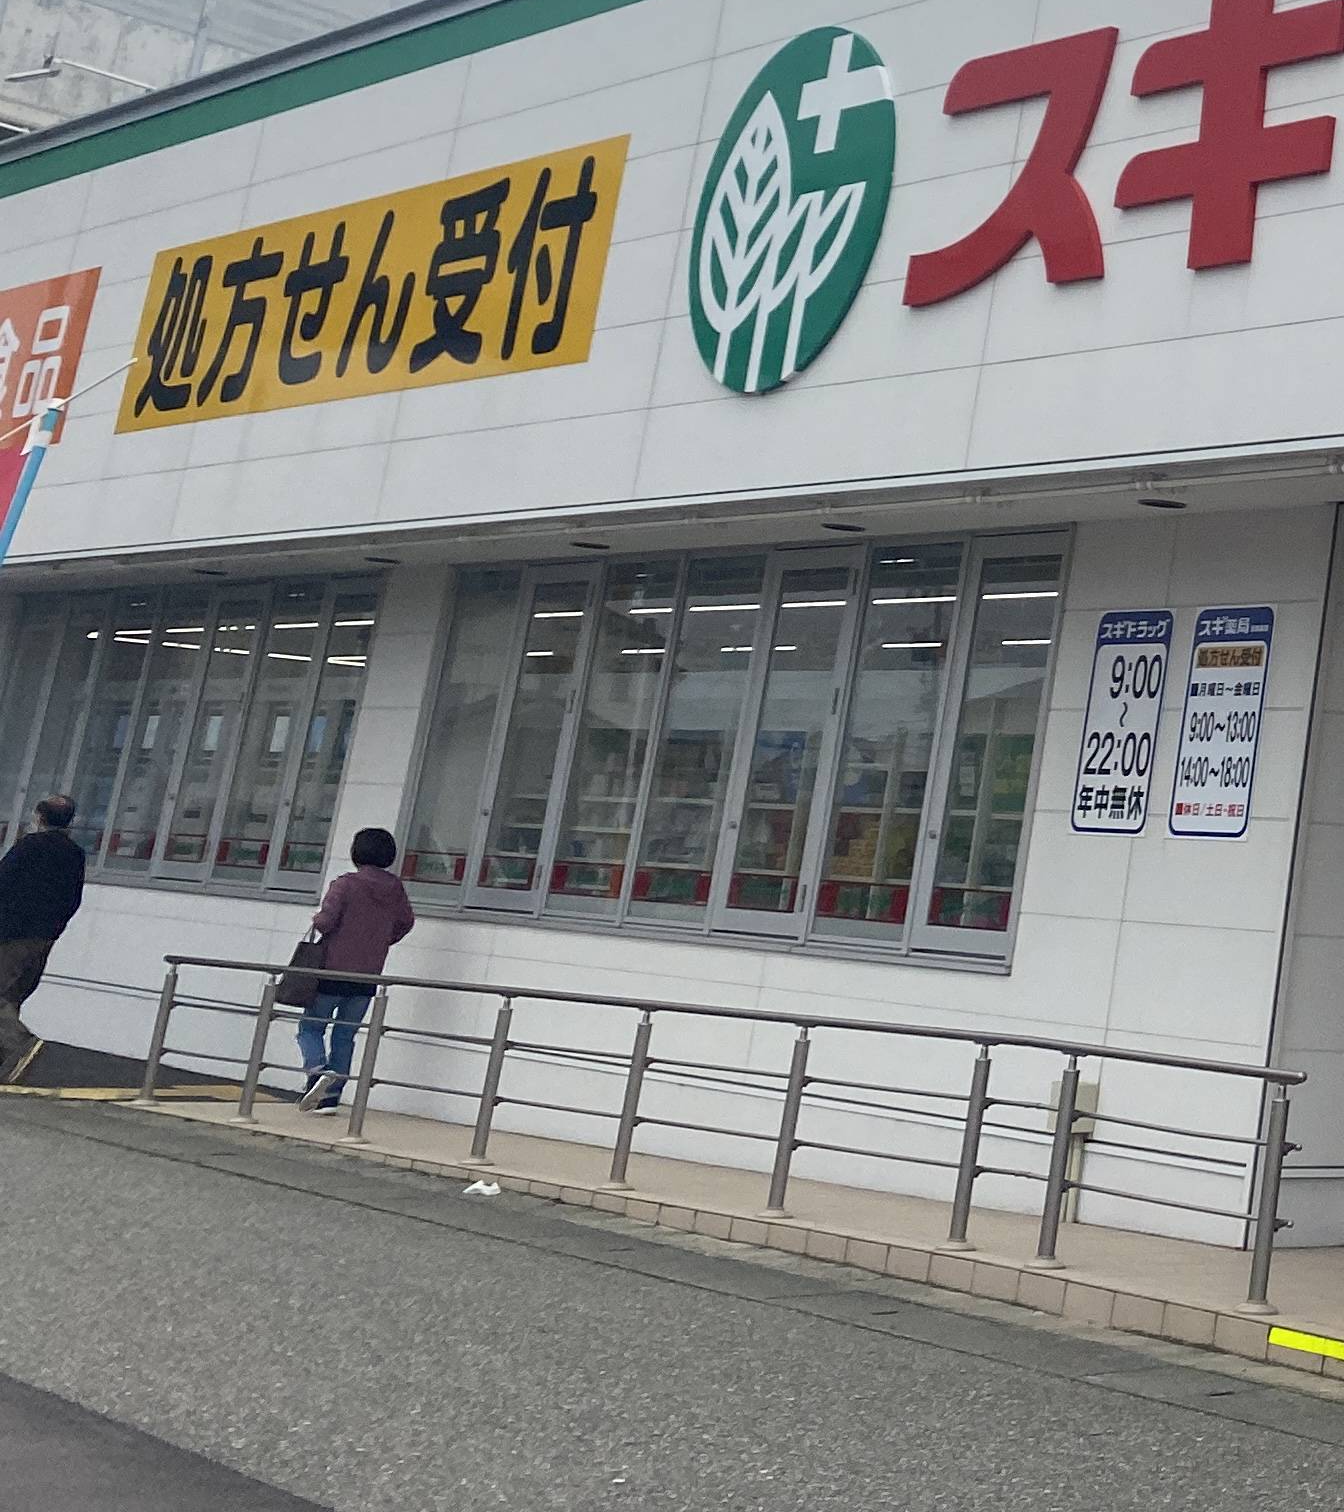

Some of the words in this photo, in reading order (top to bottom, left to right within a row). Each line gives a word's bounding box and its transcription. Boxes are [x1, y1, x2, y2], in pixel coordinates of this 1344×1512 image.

[134, 155, 599, 418] 処方せん受付
[1101, 619, 1171, 639] スギドラッグ
[1199, 615, 1250, 636] スギ薬局
[1198, 646, 1263, 667] 処方せん受付
[1110, 654, 1163, 700] 9:00
[1083, 731, 1151, 777] 22:00
[1077, 784, 1145, 821] 年中無休
